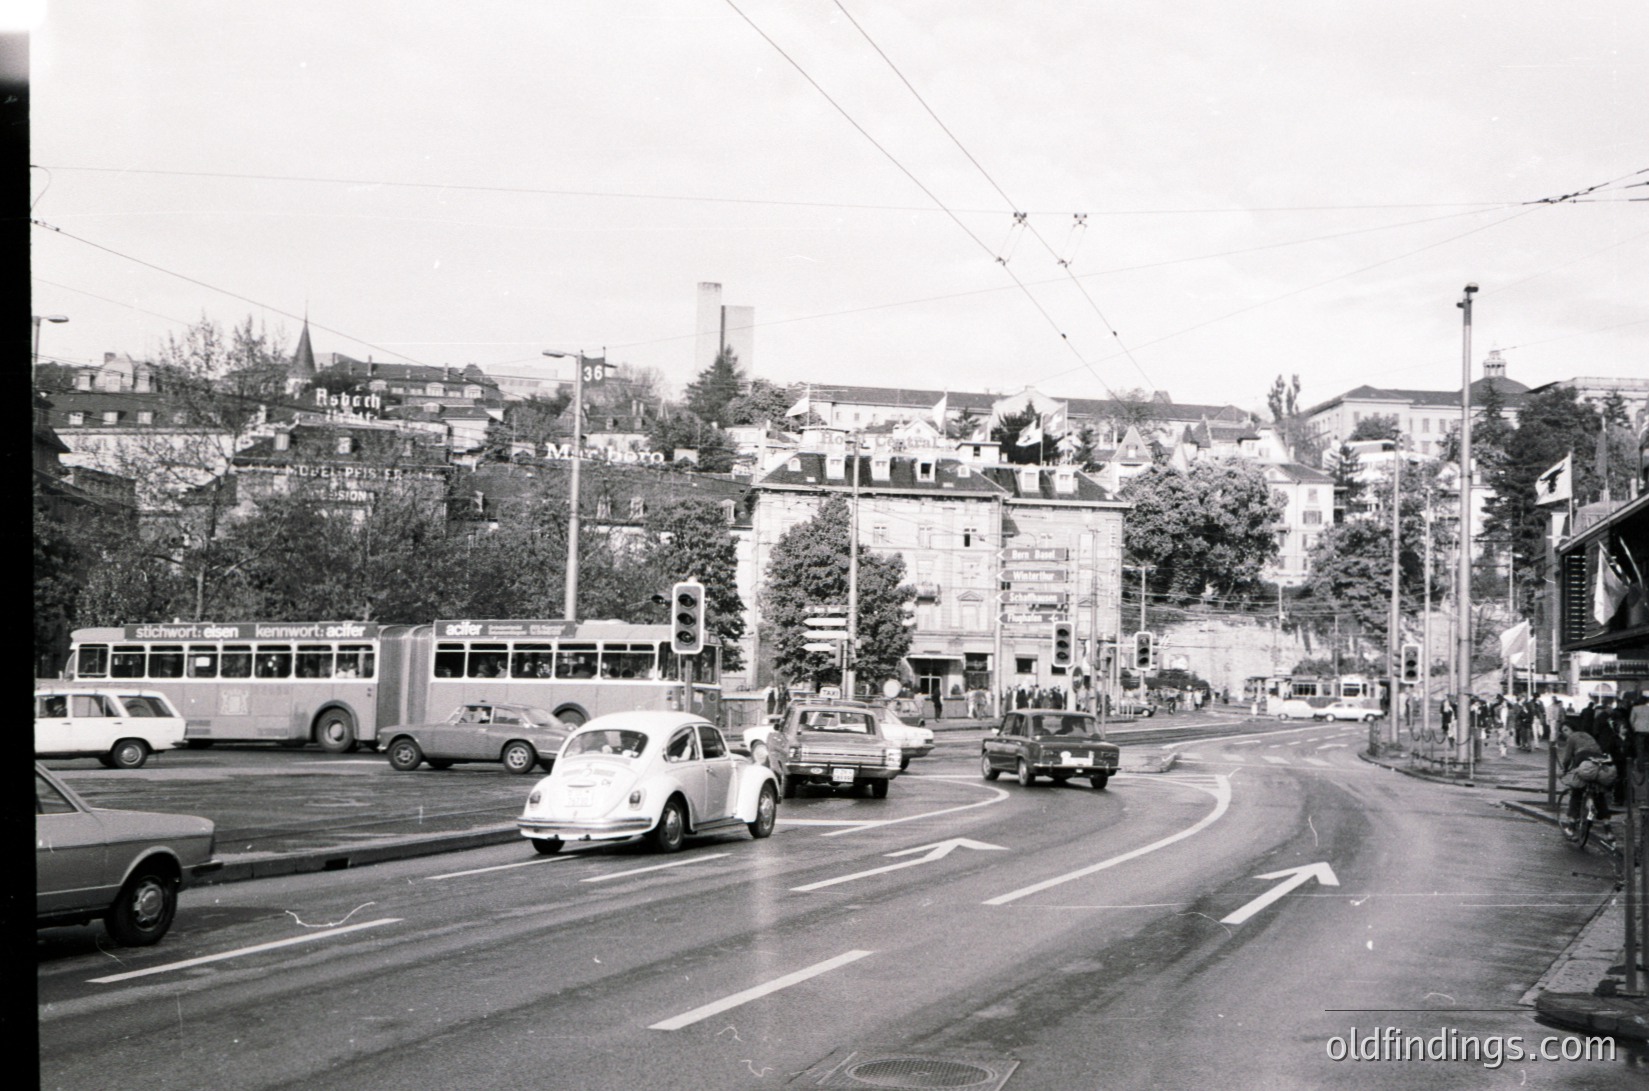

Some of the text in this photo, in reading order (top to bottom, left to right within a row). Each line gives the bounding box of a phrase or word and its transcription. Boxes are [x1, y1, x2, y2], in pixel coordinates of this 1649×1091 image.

[583, 364, 603, 382] 36
[545, 441, 665, 465] Mrboro
[1012, 549, 1055, 559] Bern Basel
[1013, 571, 1054, 580] Winterthur
[136, 622, 366, 639] stichwort: eisen kennwort: acifer
